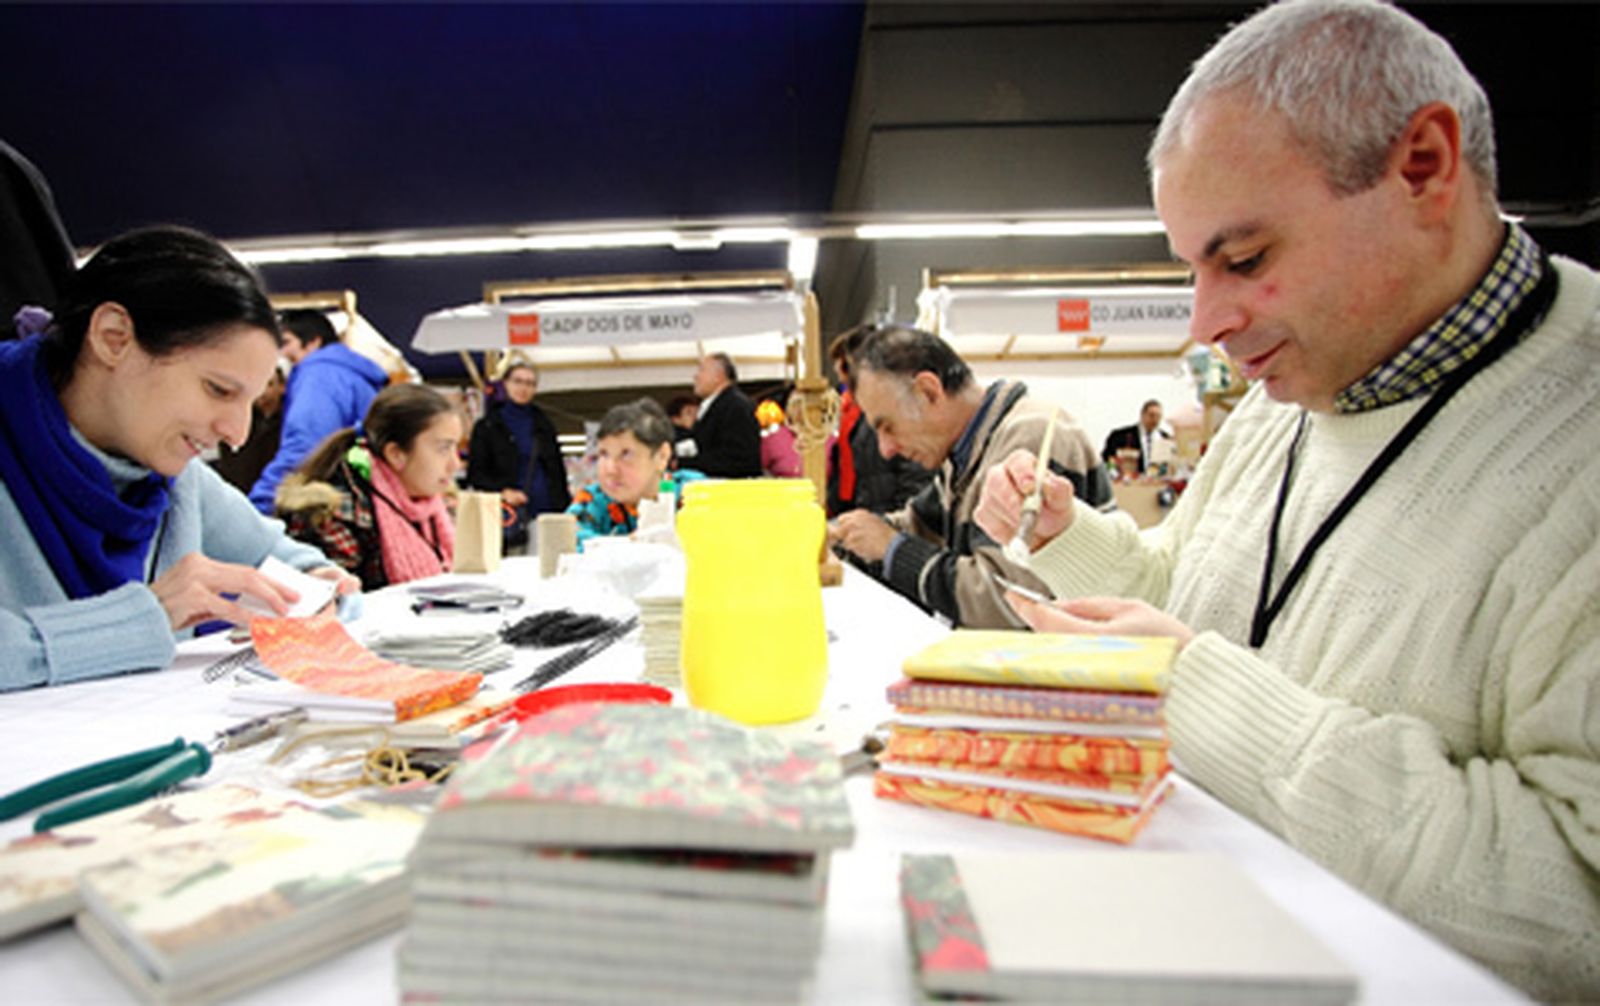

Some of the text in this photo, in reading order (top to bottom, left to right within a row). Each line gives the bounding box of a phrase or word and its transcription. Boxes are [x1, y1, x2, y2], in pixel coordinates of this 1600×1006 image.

[1113, 304, 1144, 321] JUAN
[542, 312, 693, 334] CADP DOS DE MAYO
